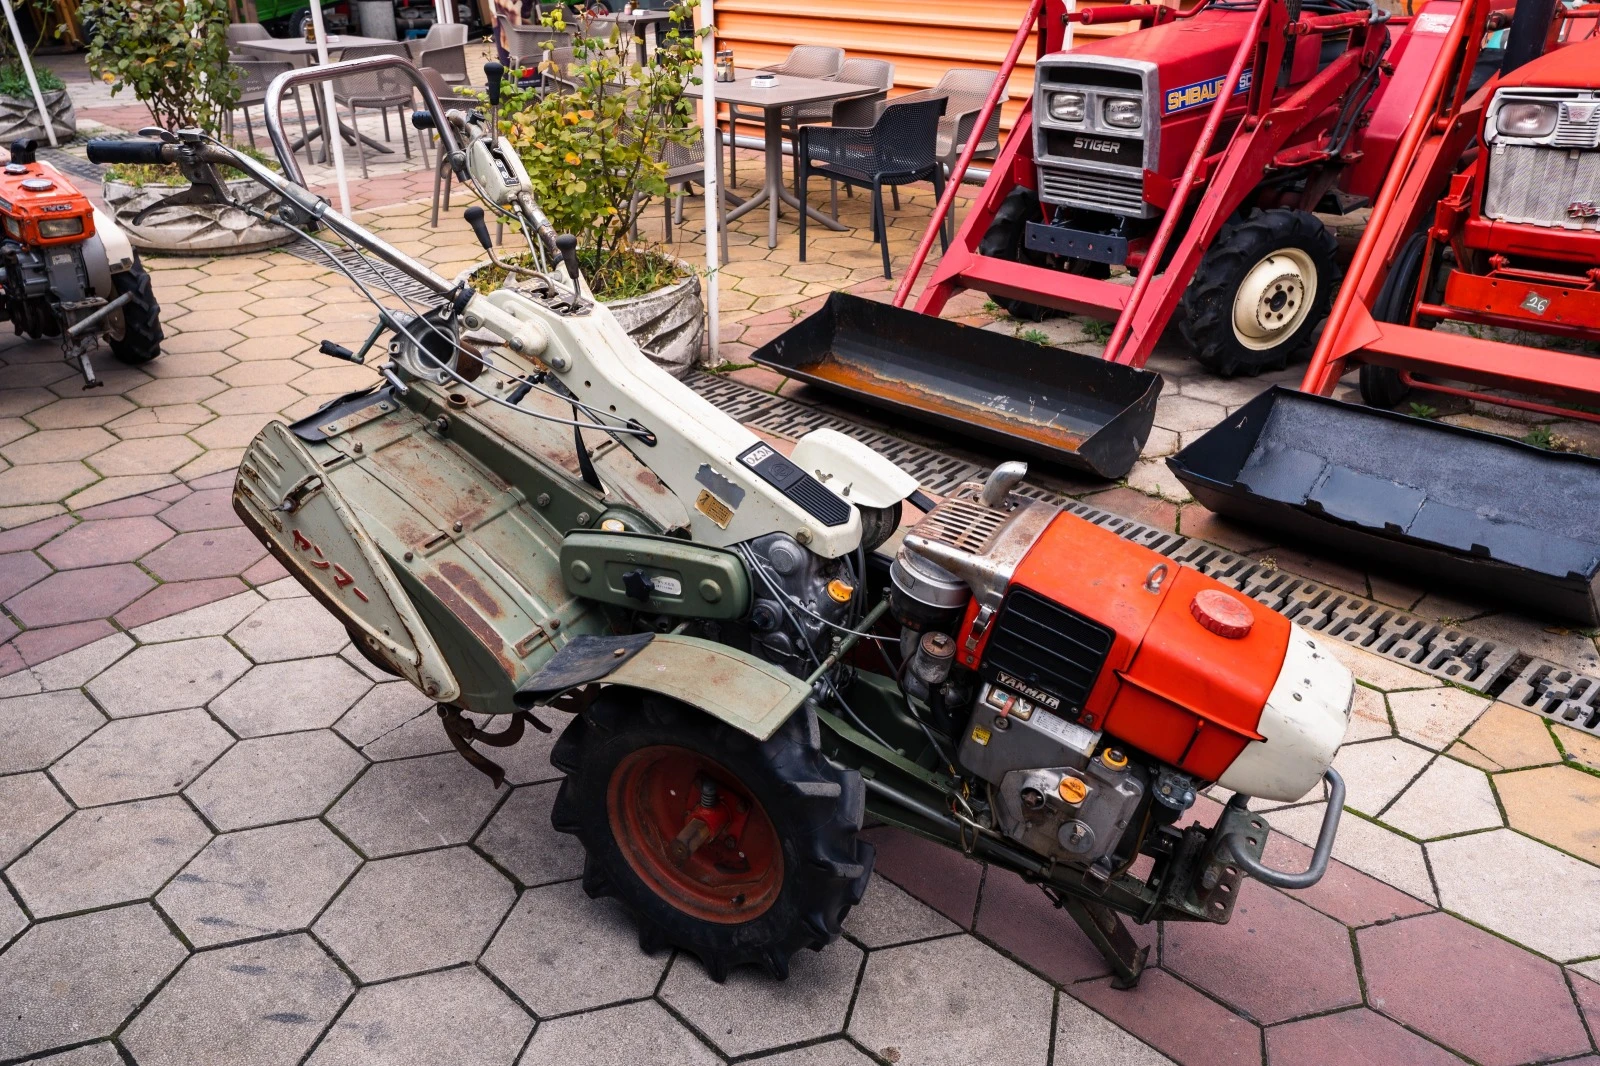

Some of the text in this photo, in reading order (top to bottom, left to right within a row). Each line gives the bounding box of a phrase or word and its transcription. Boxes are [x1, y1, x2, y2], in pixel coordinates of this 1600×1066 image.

[1167, 79, 1227, 110] SHIBAU
[1073, 137, 1120, 154] STIGER
[1526, 296, 1548, 311] 26
[292, 529, 370, 603] ヤンマー
[999, 672, 1060, 709] YANMAR
